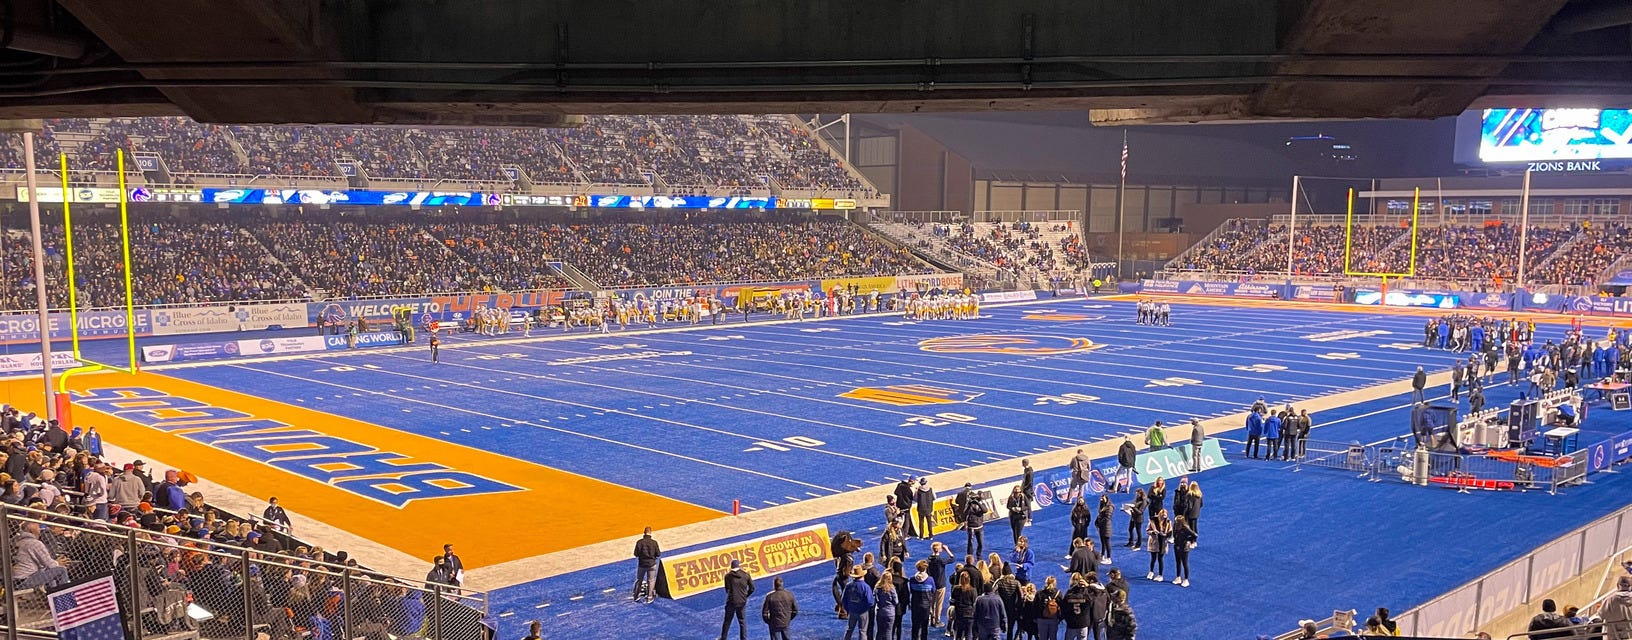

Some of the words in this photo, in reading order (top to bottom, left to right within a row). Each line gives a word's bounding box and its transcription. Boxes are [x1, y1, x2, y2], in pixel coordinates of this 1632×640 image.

[1527, 162, 1564, 172] ZIONS
[1567, 161, 1601, 171] BANK
[652, 289, 673, 299] JOIN
[674, 288, 692, 297] THE
[251, 307, 269, 315] Blue
[422, 302, 440, 314] TO
[173, 311, 191, 319] Blue
[173, 318, 196, 327] Cross
[197, 317, 206, 326] of
[206, 315, 228, 325] Idaho
[251, 314, 273, 322] Cross
[273, 313, 281, 321] of
[282, 311, 302, 320] Idaho
[328, 334, 370, 346] CAMNG
[905, 412, 977, 427] 20
[752, 436, 826, 451] 10
[763, 539, 800, 553] GROWN
[800, 535, 813, 545] IN
[765, 543, 822, 568] IDAHO
[673, 547, 757, 578] FAMOUS
